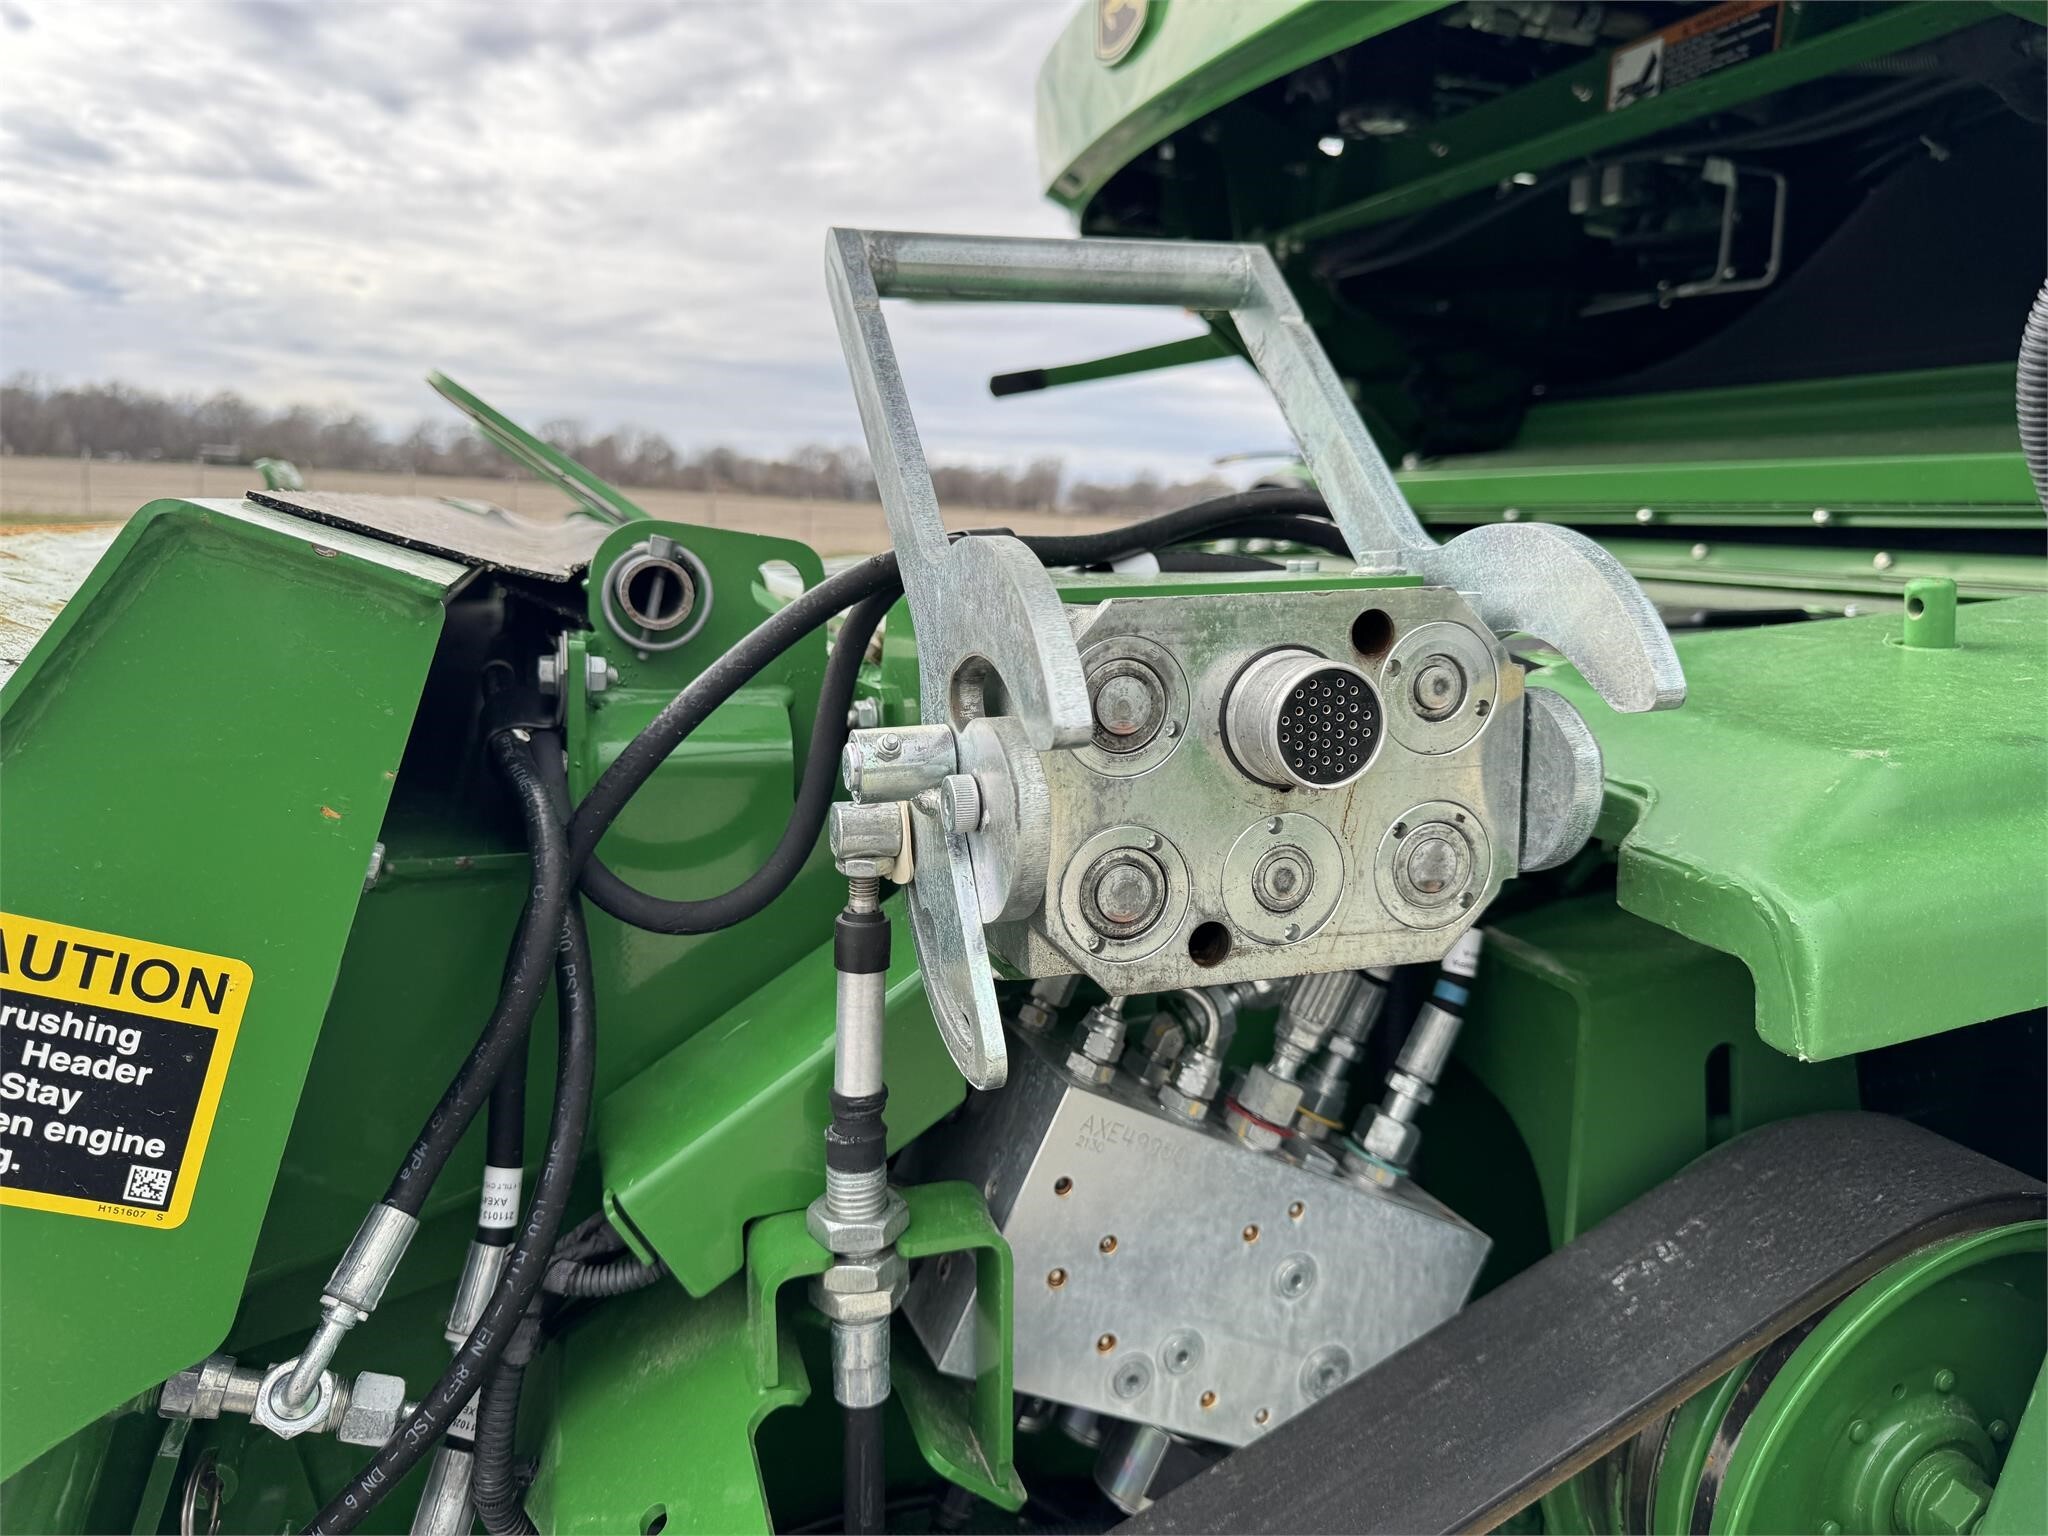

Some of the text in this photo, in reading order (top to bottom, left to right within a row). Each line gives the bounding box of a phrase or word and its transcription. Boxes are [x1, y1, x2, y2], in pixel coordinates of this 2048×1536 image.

[0, 1005, 142, 1055] rushing
[21, 1039, 153, 1086] Header
[0, 1072, 83, 1115] Stay
[44, 1121, 166, 1158] engine
[400, 1140, 429, 1181] MPa
[98, 1204, 164, 1221] H151607 S
[470, 1326, 495, 1357] EN
[360, 1466, 387, 1494] DN
[344, 1494, 358, 1511] 6
